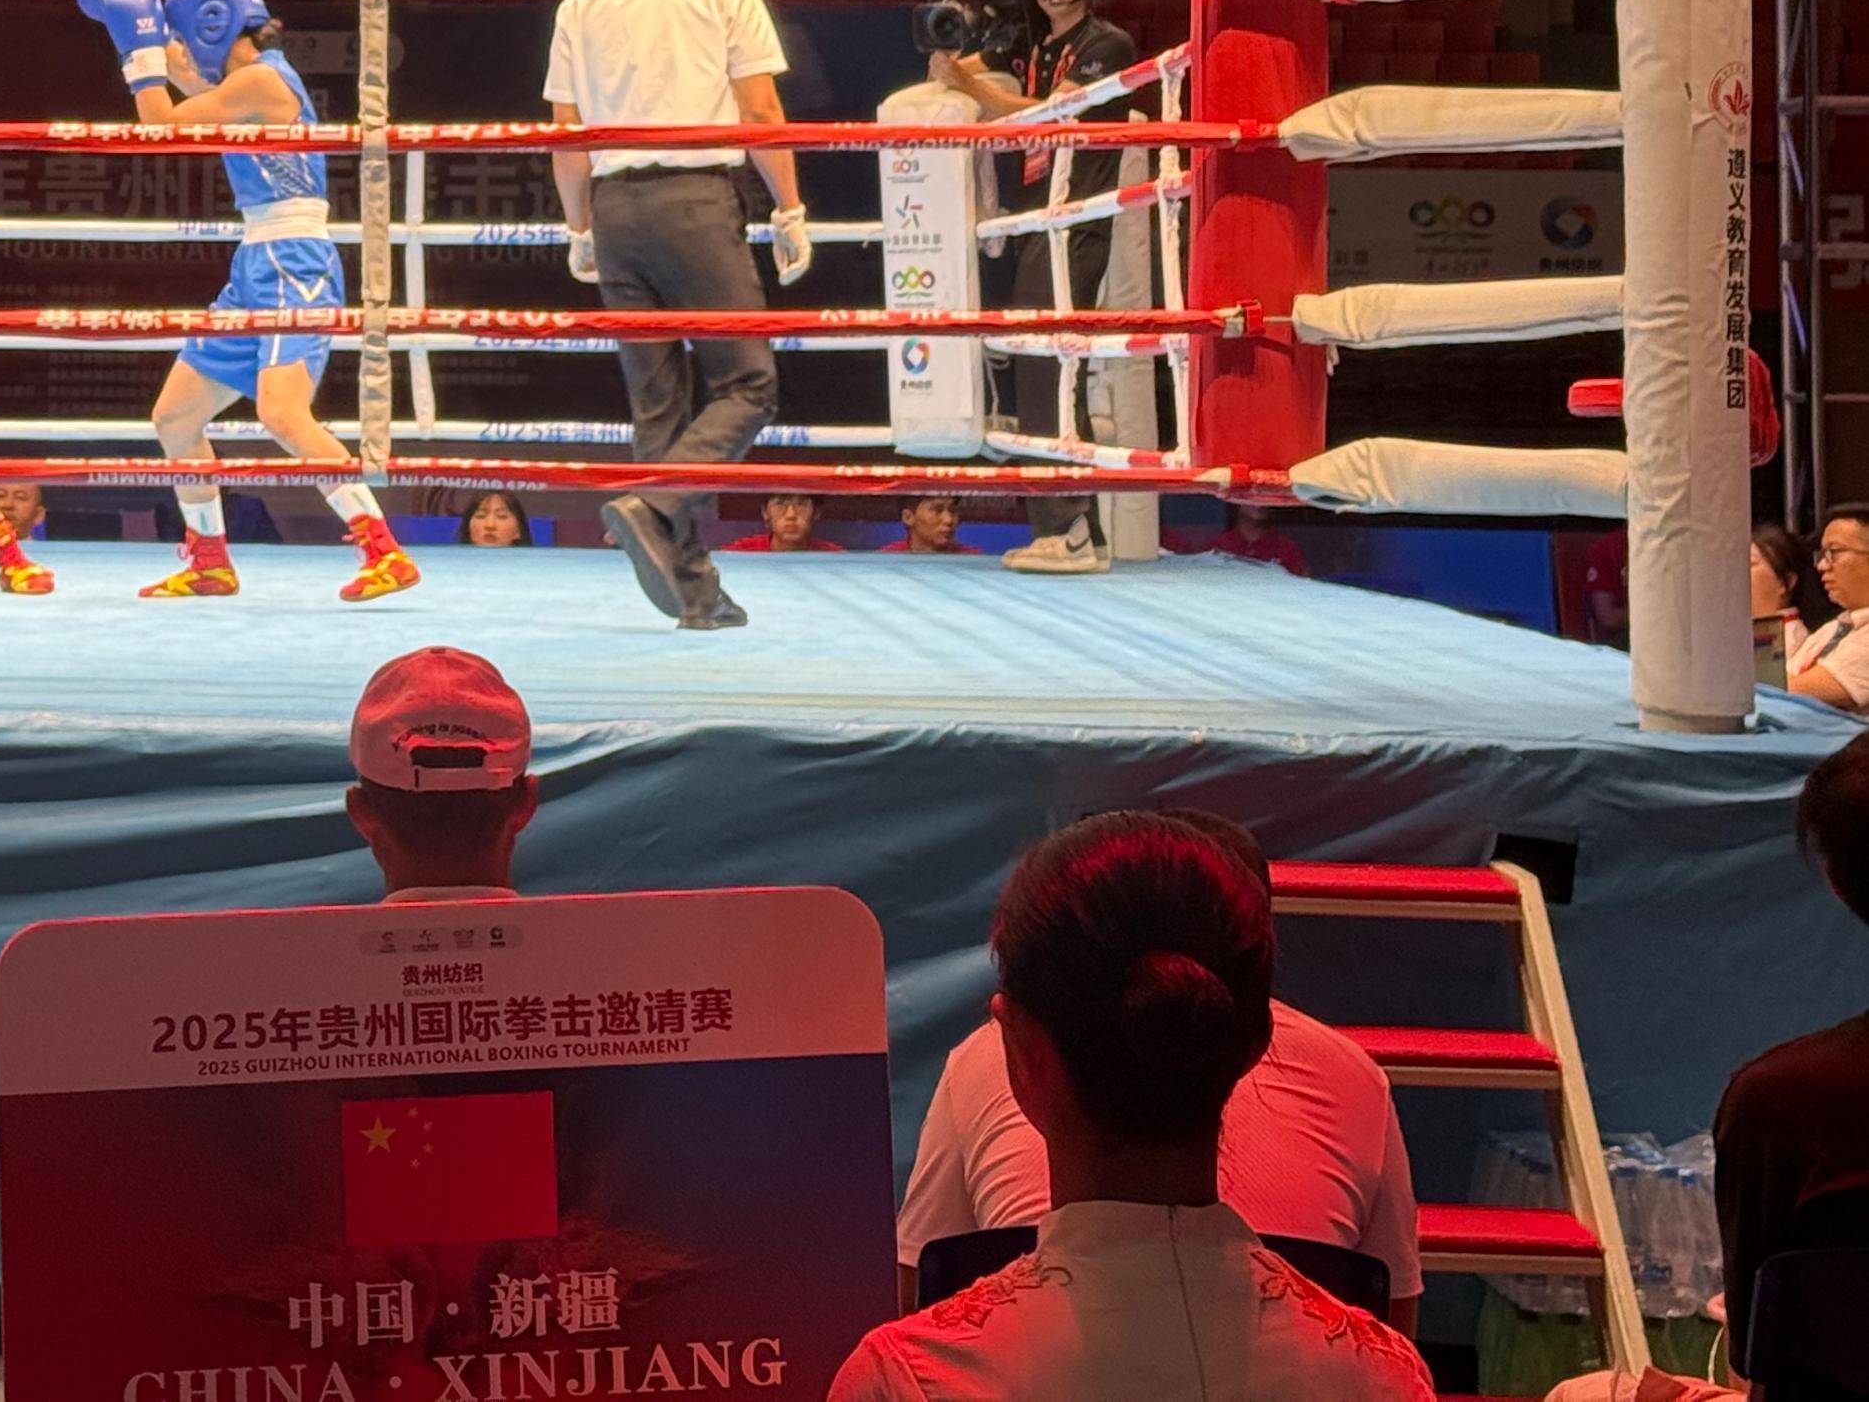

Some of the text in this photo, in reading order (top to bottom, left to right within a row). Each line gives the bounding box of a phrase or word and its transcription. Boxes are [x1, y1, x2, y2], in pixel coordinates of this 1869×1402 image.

[1725, 147, 1751, 410] 遵义教育发展集团
[86, 472, 206, 487] TOURNAMENT
[210, 473, 278, 487] BOXING
[402, 962, 484, 986] 贵州纺织
[402, 987, 446, 998] GUIZHOU
[151, 988, 734, 1053] 2025年贵州国际拳击邀请赛
[197, 1037, 691, 1076] 2025 GUIZHOU INTERNATIONAL BOXING TOURNAMENT
[124, 1336, 788, 1402] CHINA XINJIANG
